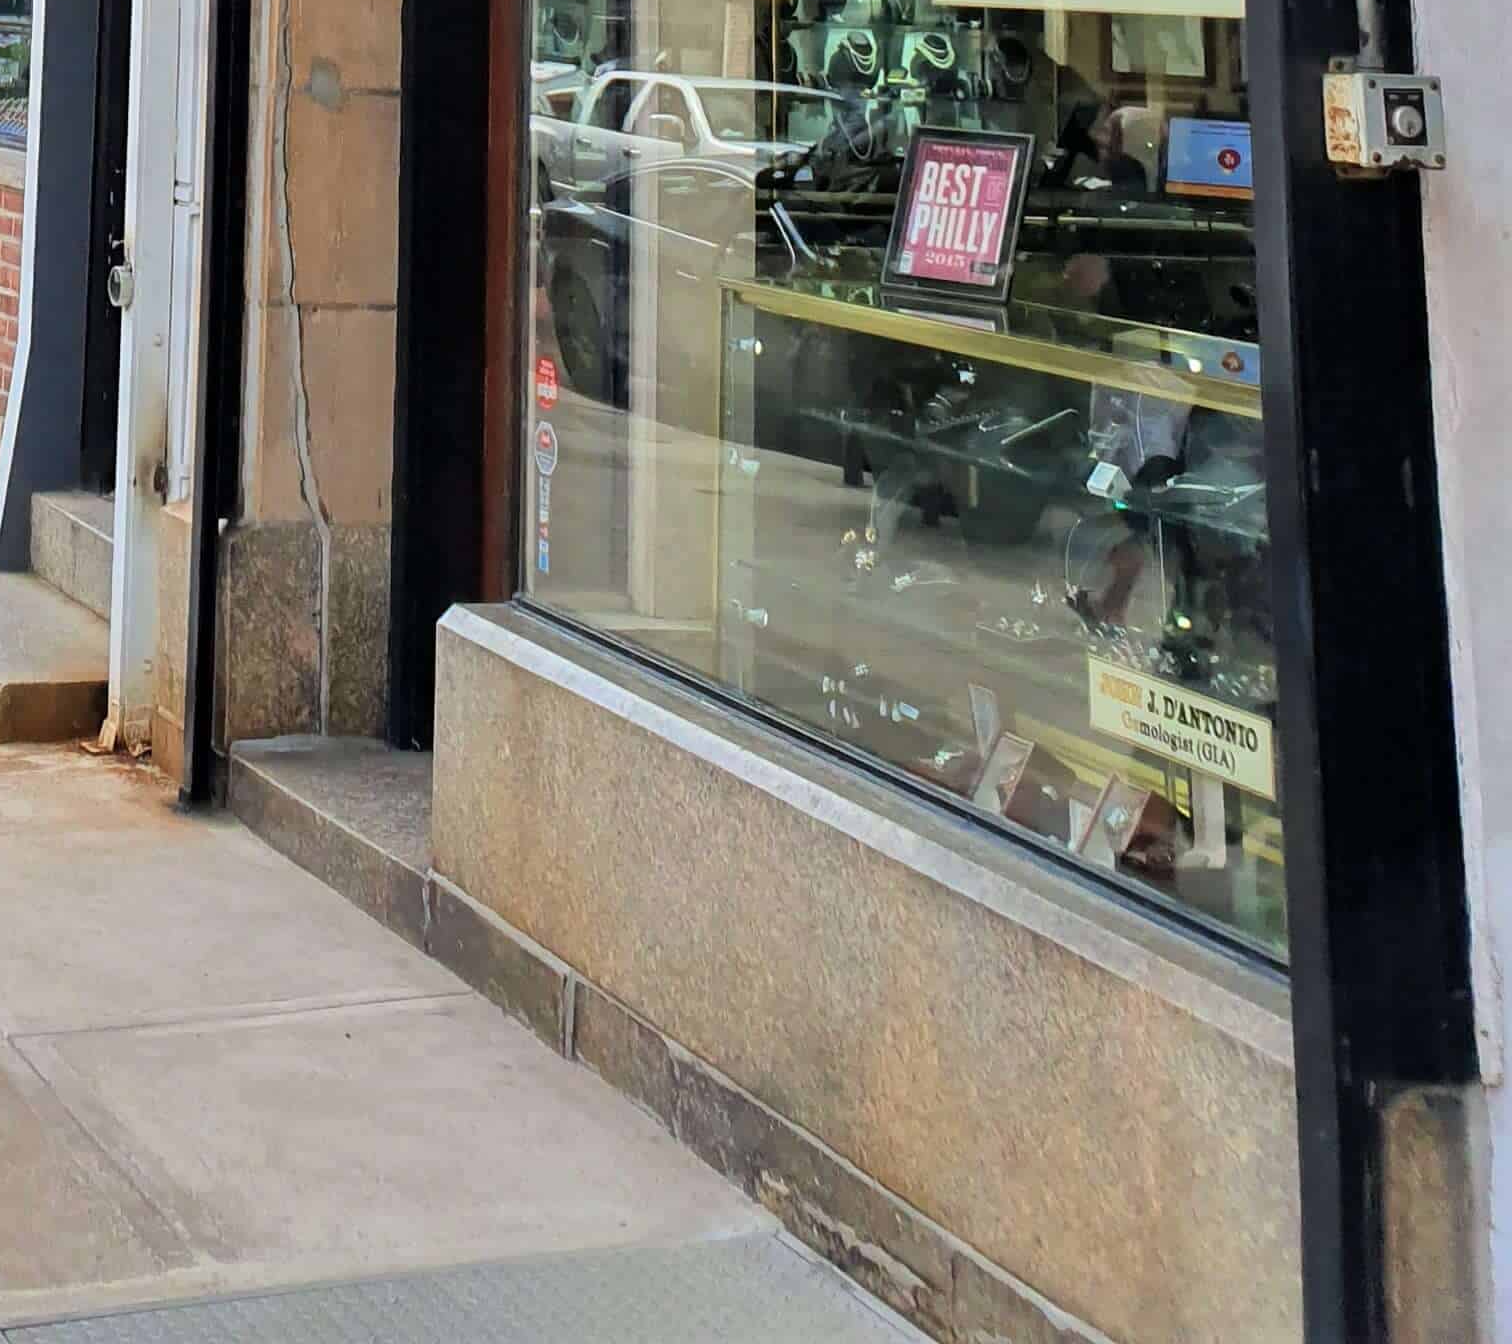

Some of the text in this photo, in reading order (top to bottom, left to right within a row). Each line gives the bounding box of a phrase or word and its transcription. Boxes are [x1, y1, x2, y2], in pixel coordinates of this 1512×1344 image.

[920, 160, 989, 209] BEST
[907, 202, 1000, 255] PHILLY
[1147, 689, 1160, 716] J.
[1162, 695, 1259, 753] D'ANTONIO
[1196, 739, 1237, 776] (GIA)
